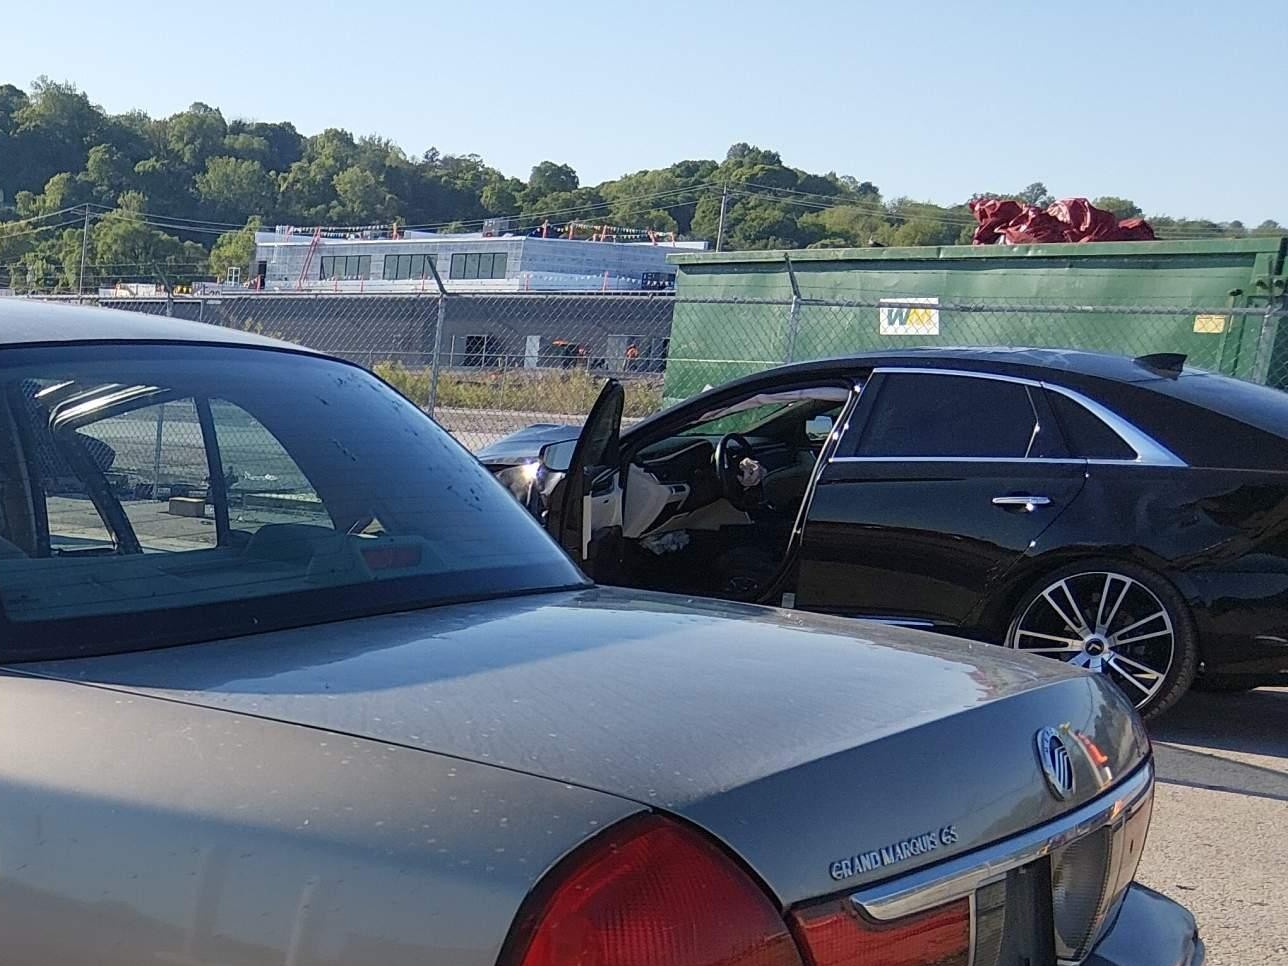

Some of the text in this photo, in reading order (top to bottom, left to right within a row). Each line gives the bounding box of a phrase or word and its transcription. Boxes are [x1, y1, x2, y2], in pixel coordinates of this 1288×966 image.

[830, 825, 959, 880] GRAND MARQUIS GS
